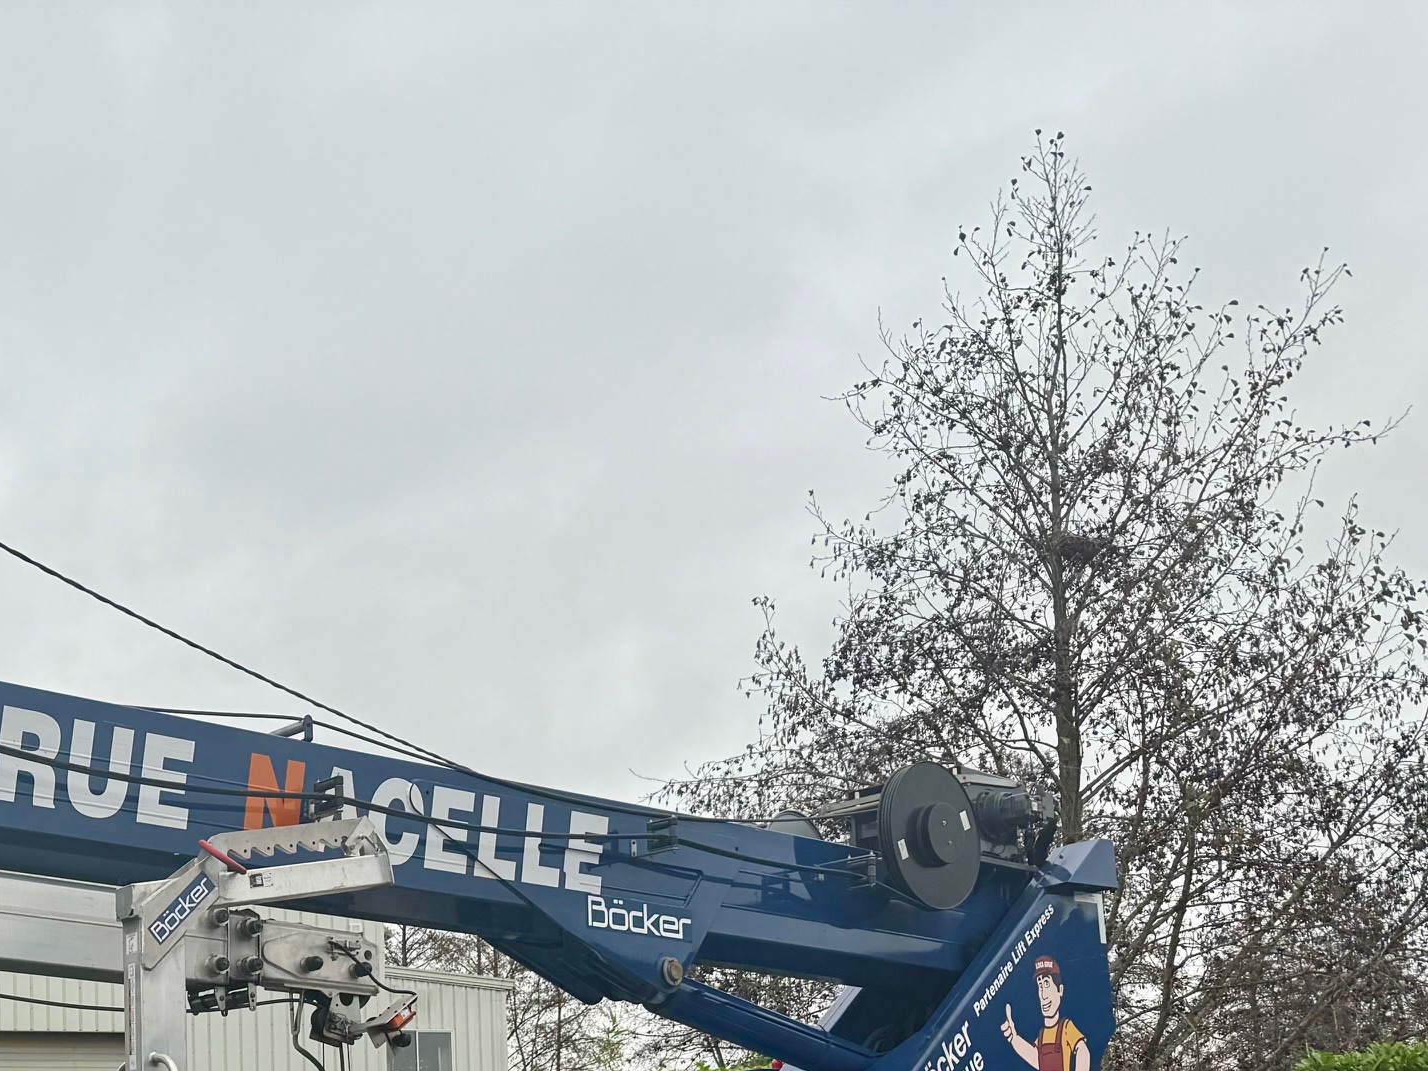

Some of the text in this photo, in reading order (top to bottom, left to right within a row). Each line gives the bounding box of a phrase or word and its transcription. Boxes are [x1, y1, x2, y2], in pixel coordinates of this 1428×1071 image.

[243, 752, 610, 895] NACELLE
[149, 876, 208, 943] Böcker
[586, 894, 692, 941] Böcker
[972, 903, 1055, 1018] Partenaire Lift Express
